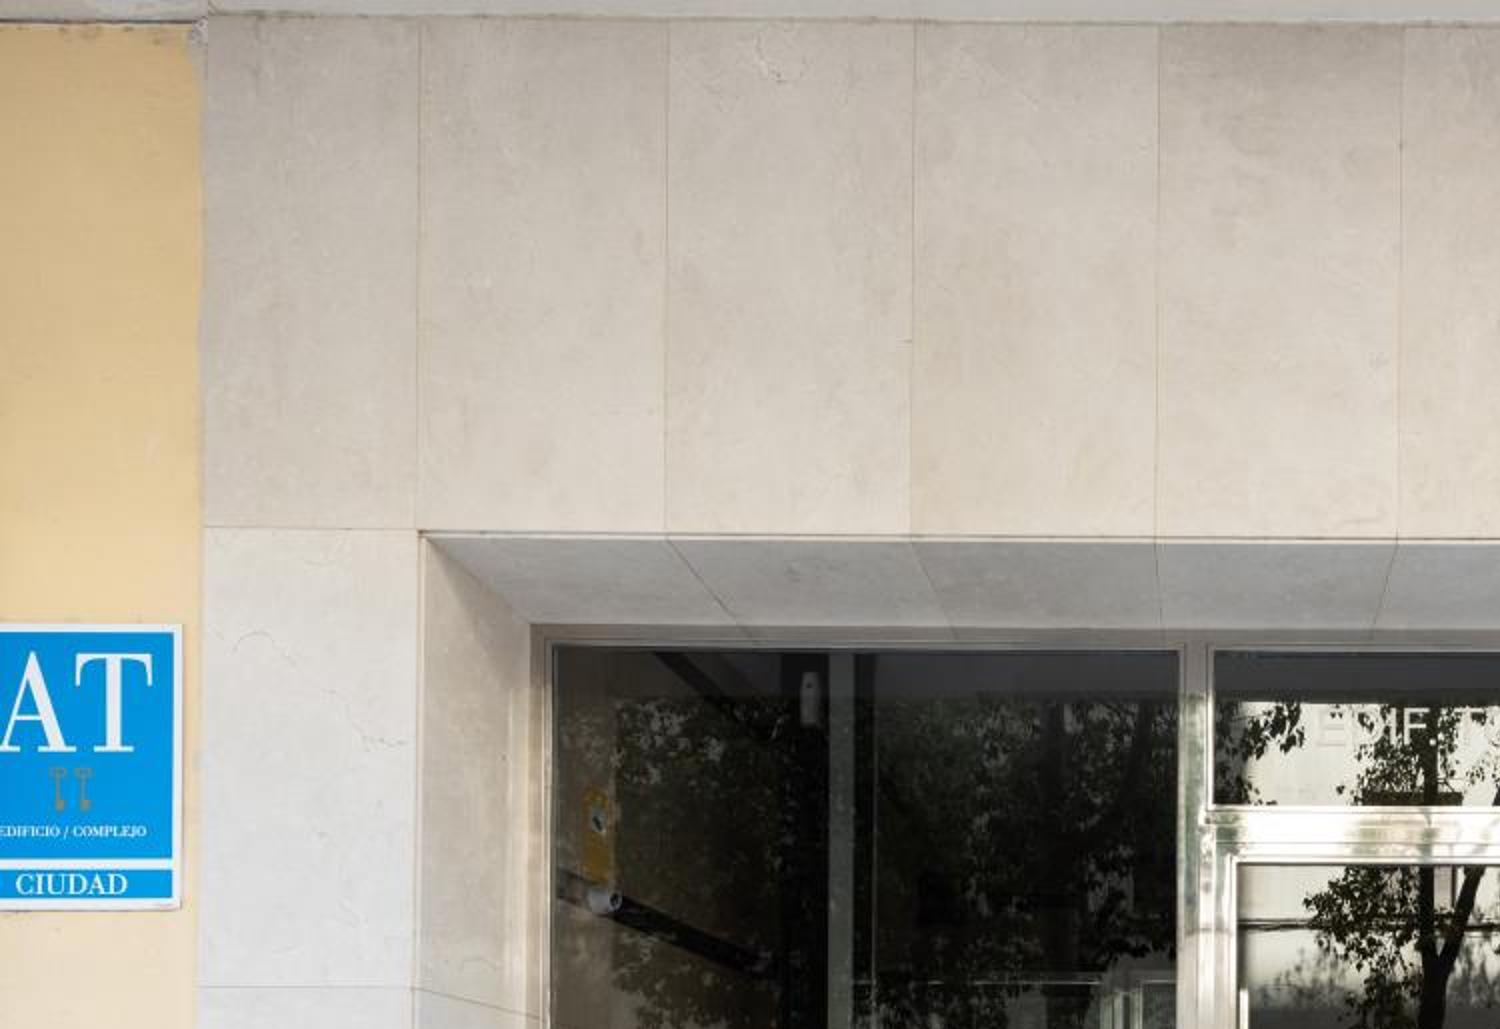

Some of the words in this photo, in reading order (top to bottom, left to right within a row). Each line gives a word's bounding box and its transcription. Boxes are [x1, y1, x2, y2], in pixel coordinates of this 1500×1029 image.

[0, 650, 153, 753] AT
[1315, 707, 1437, 746] EDIF.
[0, 825, 60, 838] EDIFICIO
[73, 825, 147, 838] COMPLEJO
[15, 873, 128, 895] CIUDAD
